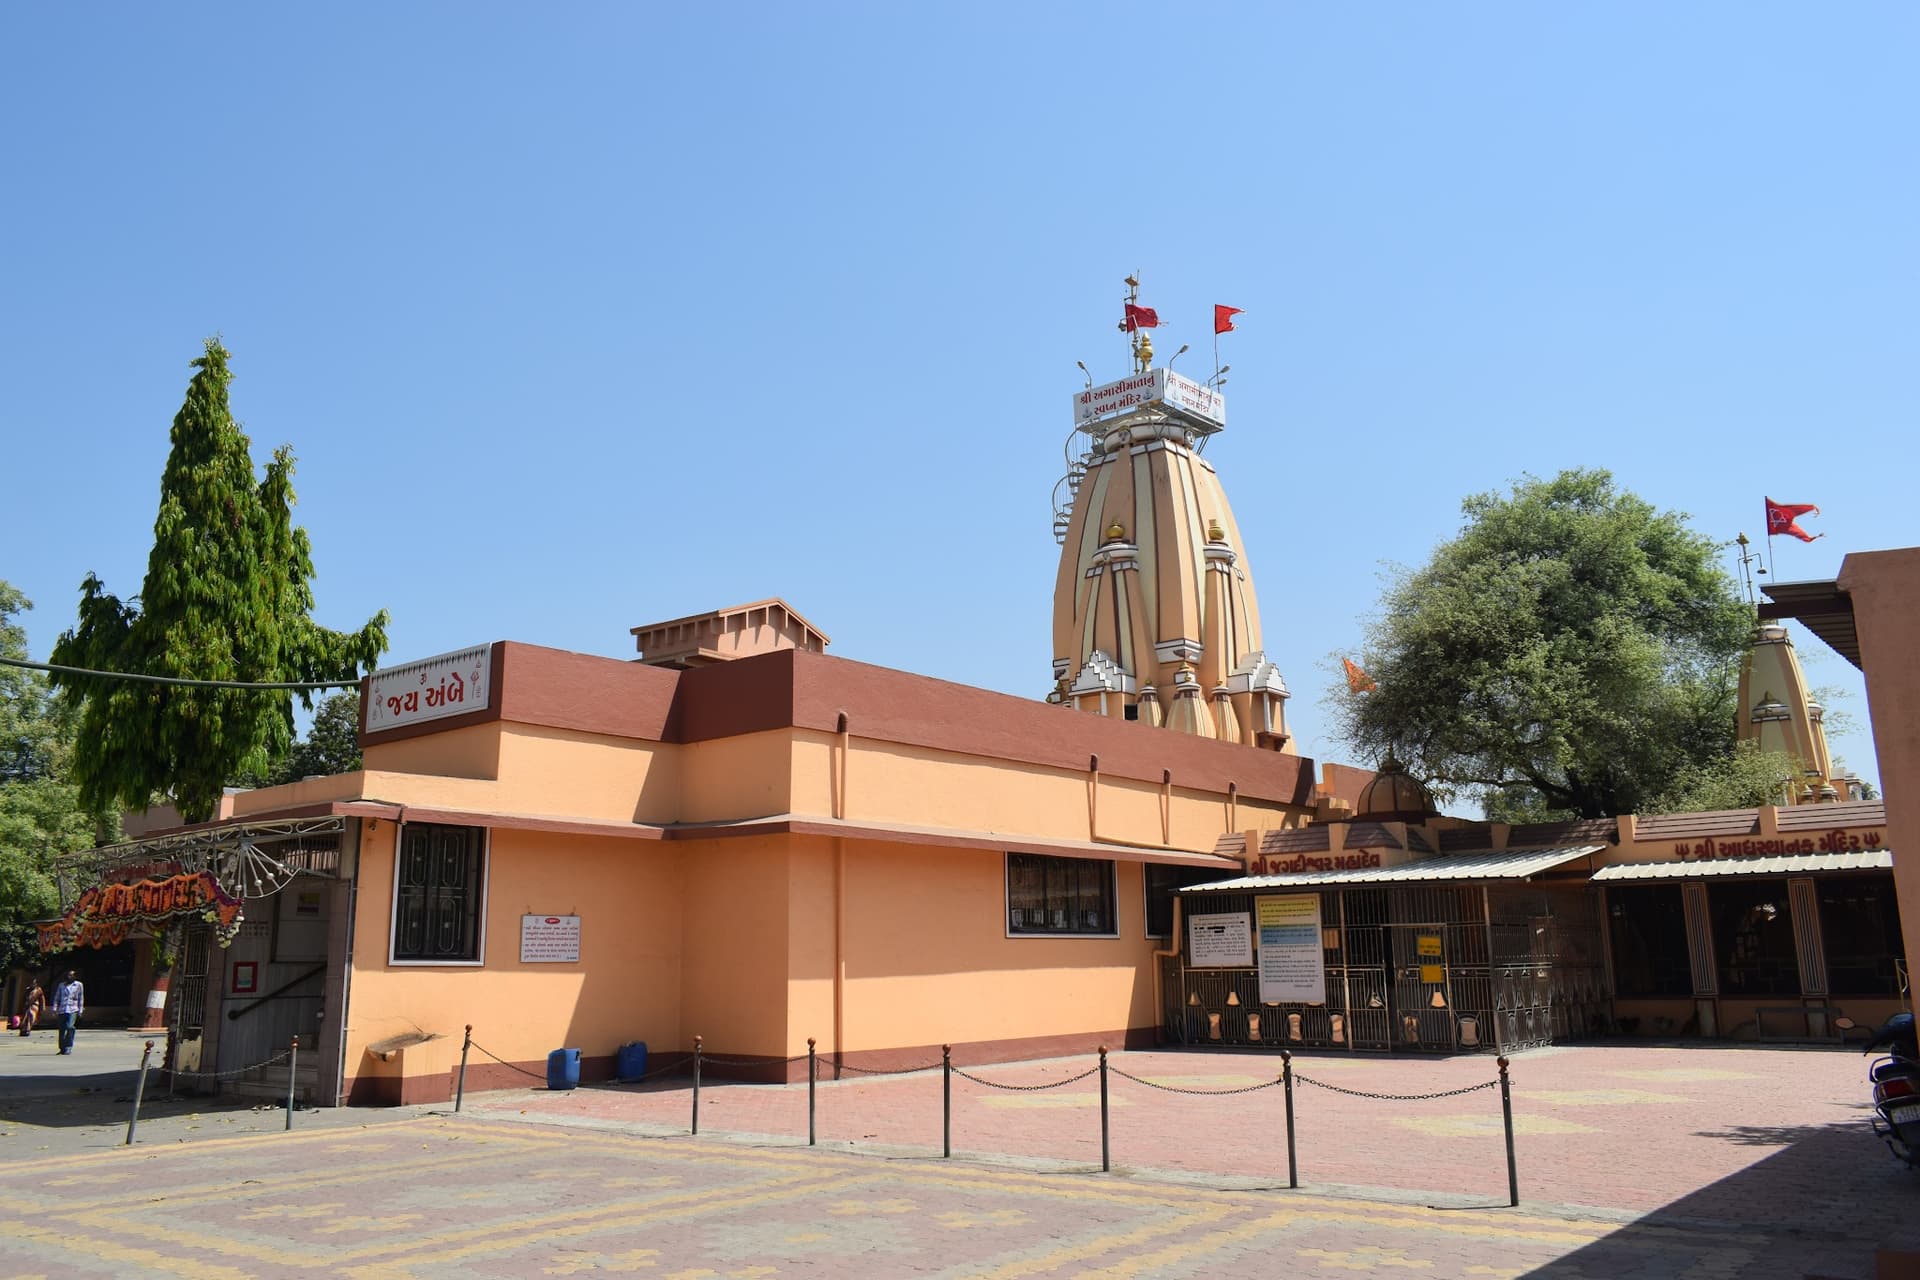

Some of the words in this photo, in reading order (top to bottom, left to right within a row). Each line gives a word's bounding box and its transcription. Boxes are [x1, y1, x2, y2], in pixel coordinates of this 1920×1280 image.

[1080, 391, 1092, 405] શ્રી
[1119, 393, 1142, 408] મંદિર
[387, 690, 419, 716] જય
[425, 671, 465, 708] અંબે
[1694, 837, 1715, 859] શ્રી
[1819, 829, 1862, 854] મંદિર
[1251, 855, 1268, 875] શ્રી
[1334, 848, 1380, 870] મહાદેવ
